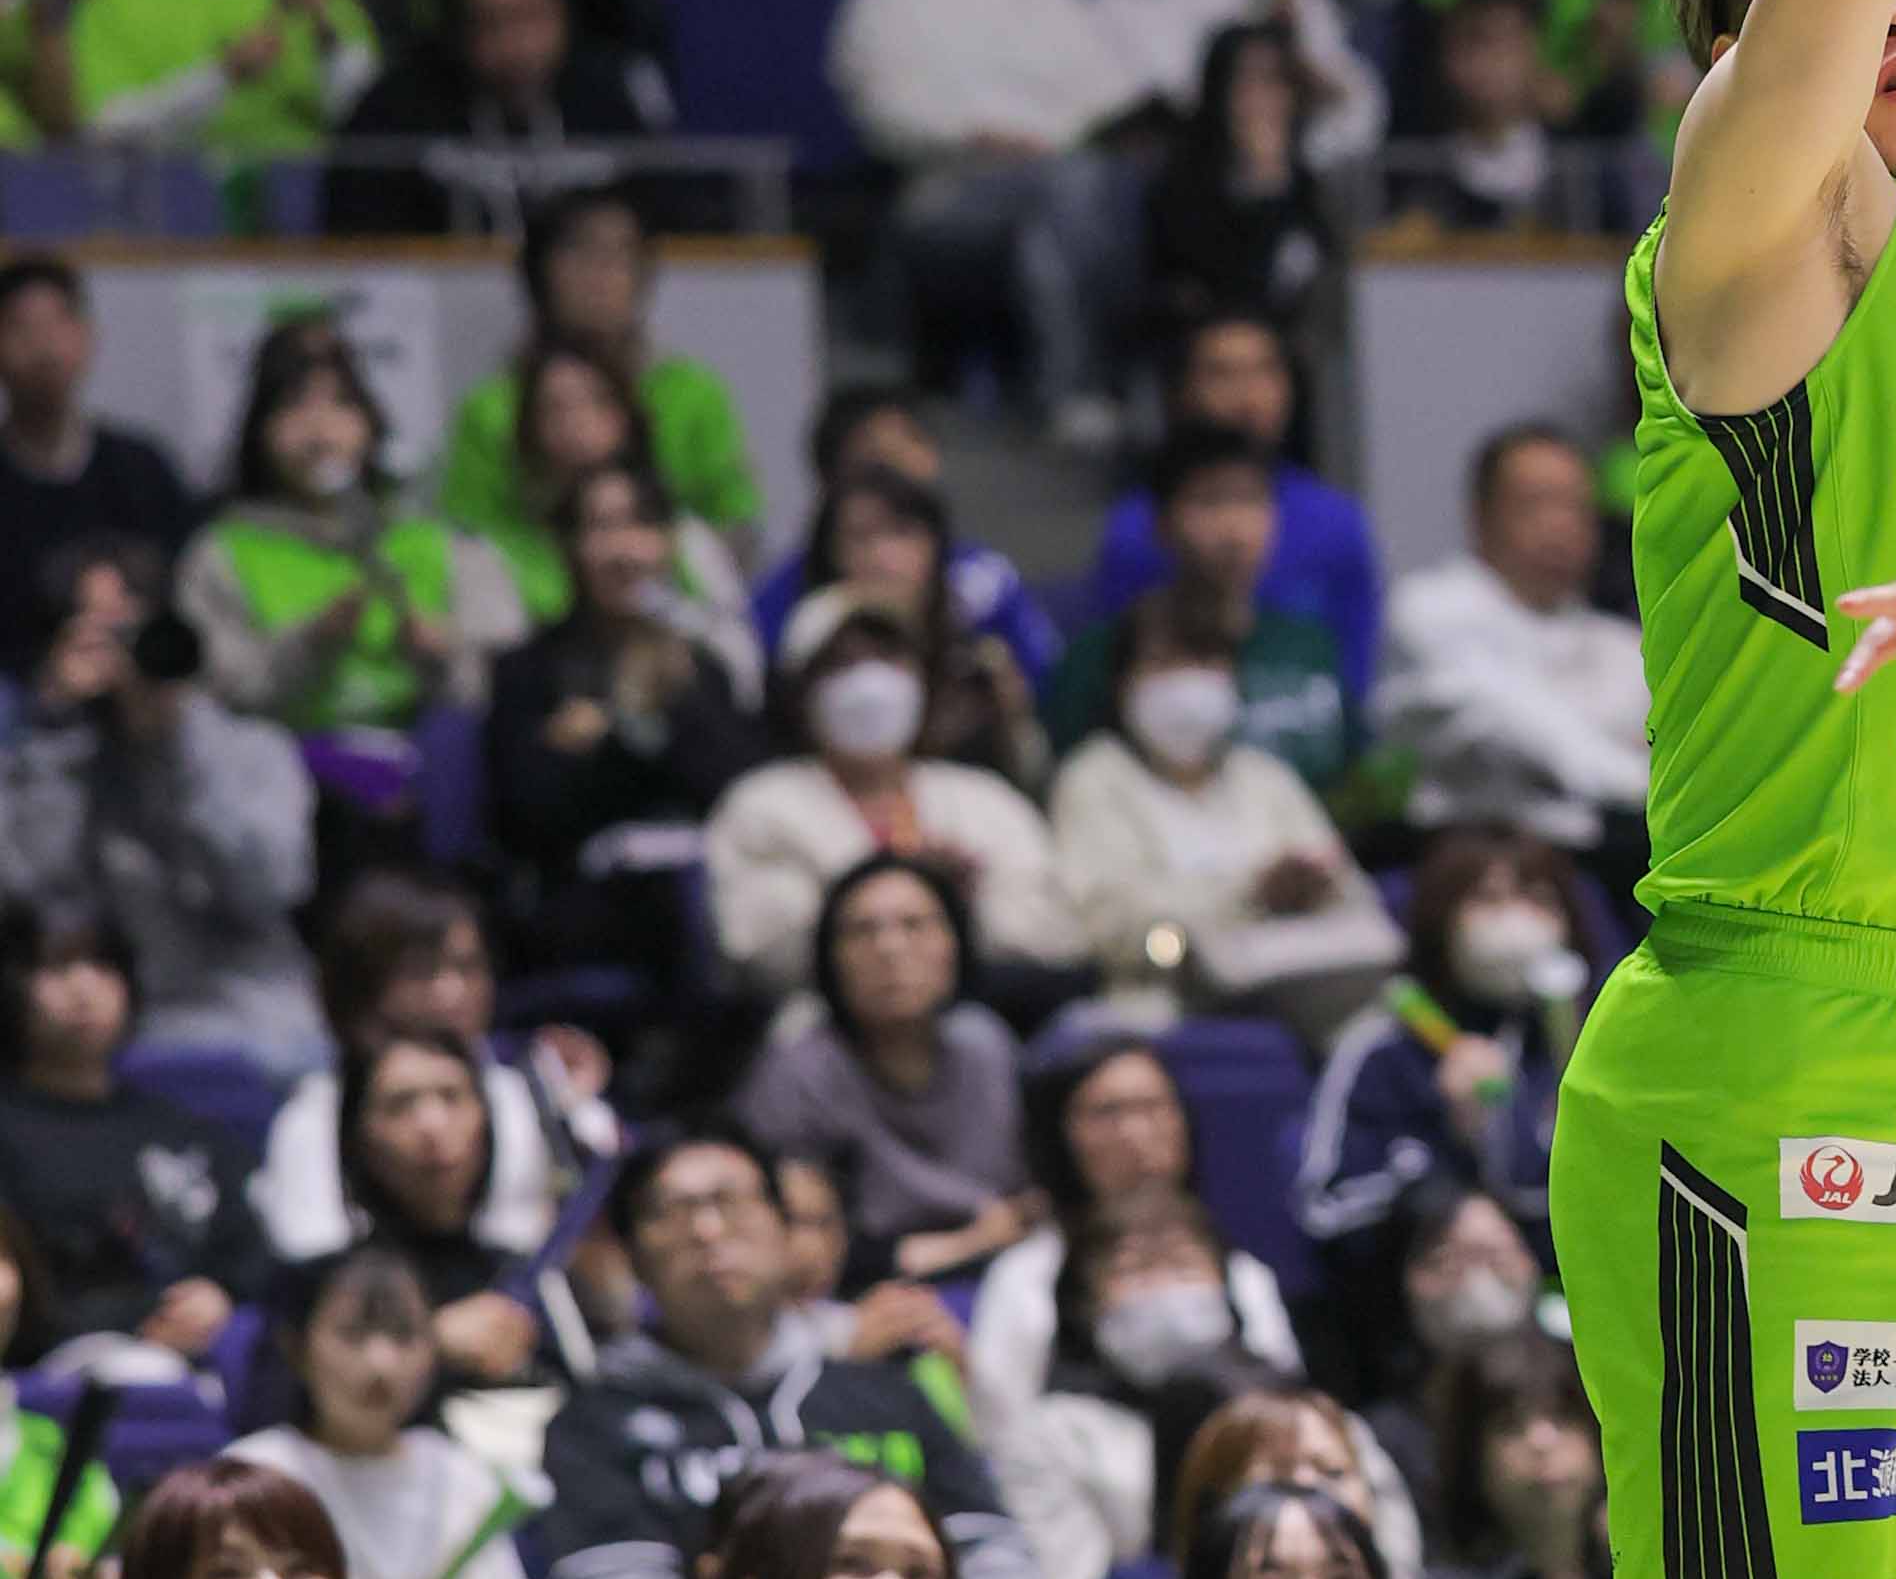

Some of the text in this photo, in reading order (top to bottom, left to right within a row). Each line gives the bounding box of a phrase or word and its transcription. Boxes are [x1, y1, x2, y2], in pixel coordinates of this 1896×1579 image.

[1819, 1189, 1851, 1205] JAL
[1852, 1347, 1891, 1368] 学校
[1852, 1369, 1892, 1388] 法人
